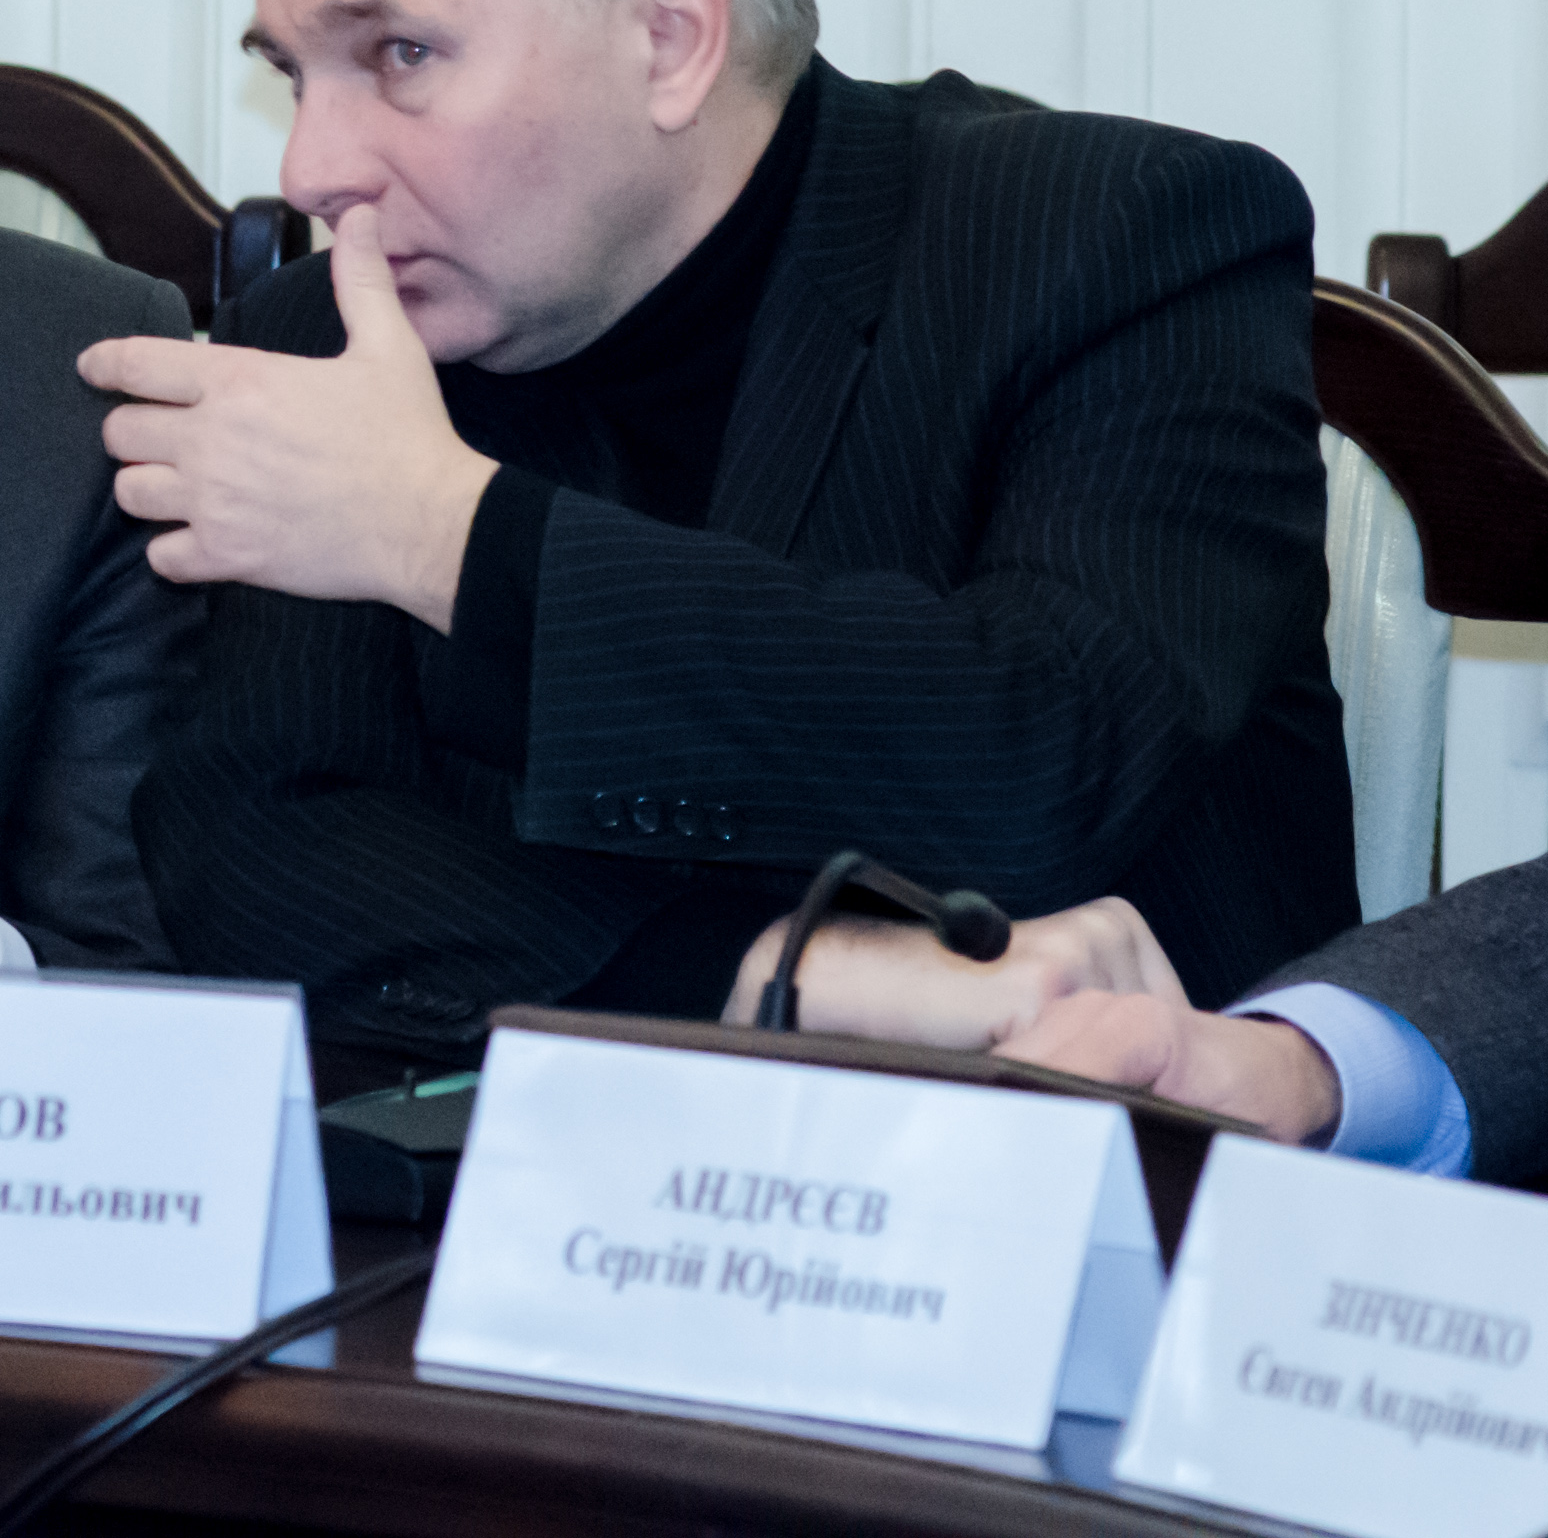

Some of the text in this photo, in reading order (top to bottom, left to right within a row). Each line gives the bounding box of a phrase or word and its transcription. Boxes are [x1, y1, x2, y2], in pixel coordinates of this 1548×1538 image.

[655, 1166, 890, 1237] АНДРЄЄВ
[562, 1226, 946, 1323] Сергій Юрійович
